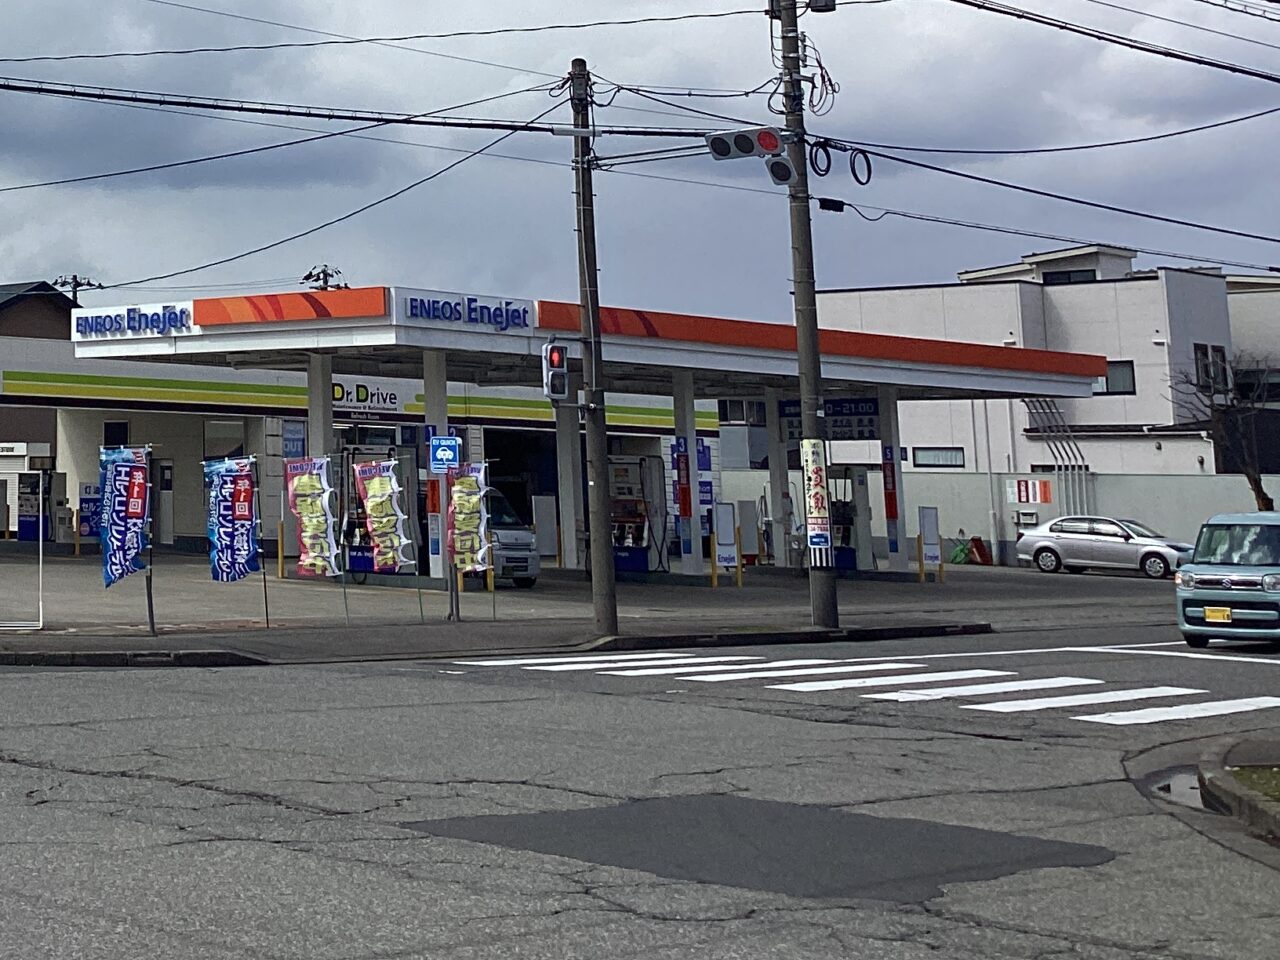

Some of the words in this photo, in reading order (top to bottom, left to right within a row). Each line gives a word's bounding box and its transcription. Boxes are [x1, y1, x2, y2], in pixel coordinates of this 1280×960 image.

[76, 313, 126, 338] ENEOS
[127, 305, 192, 334] Enejet
[409, 297, 462, 321] ENEOS
[466, 297, 529, 331] Enejet
[332, 382, 353, 402] Dr.
[356, 384, 397, 405] Drive
[679, 438, 686, 452] 3
